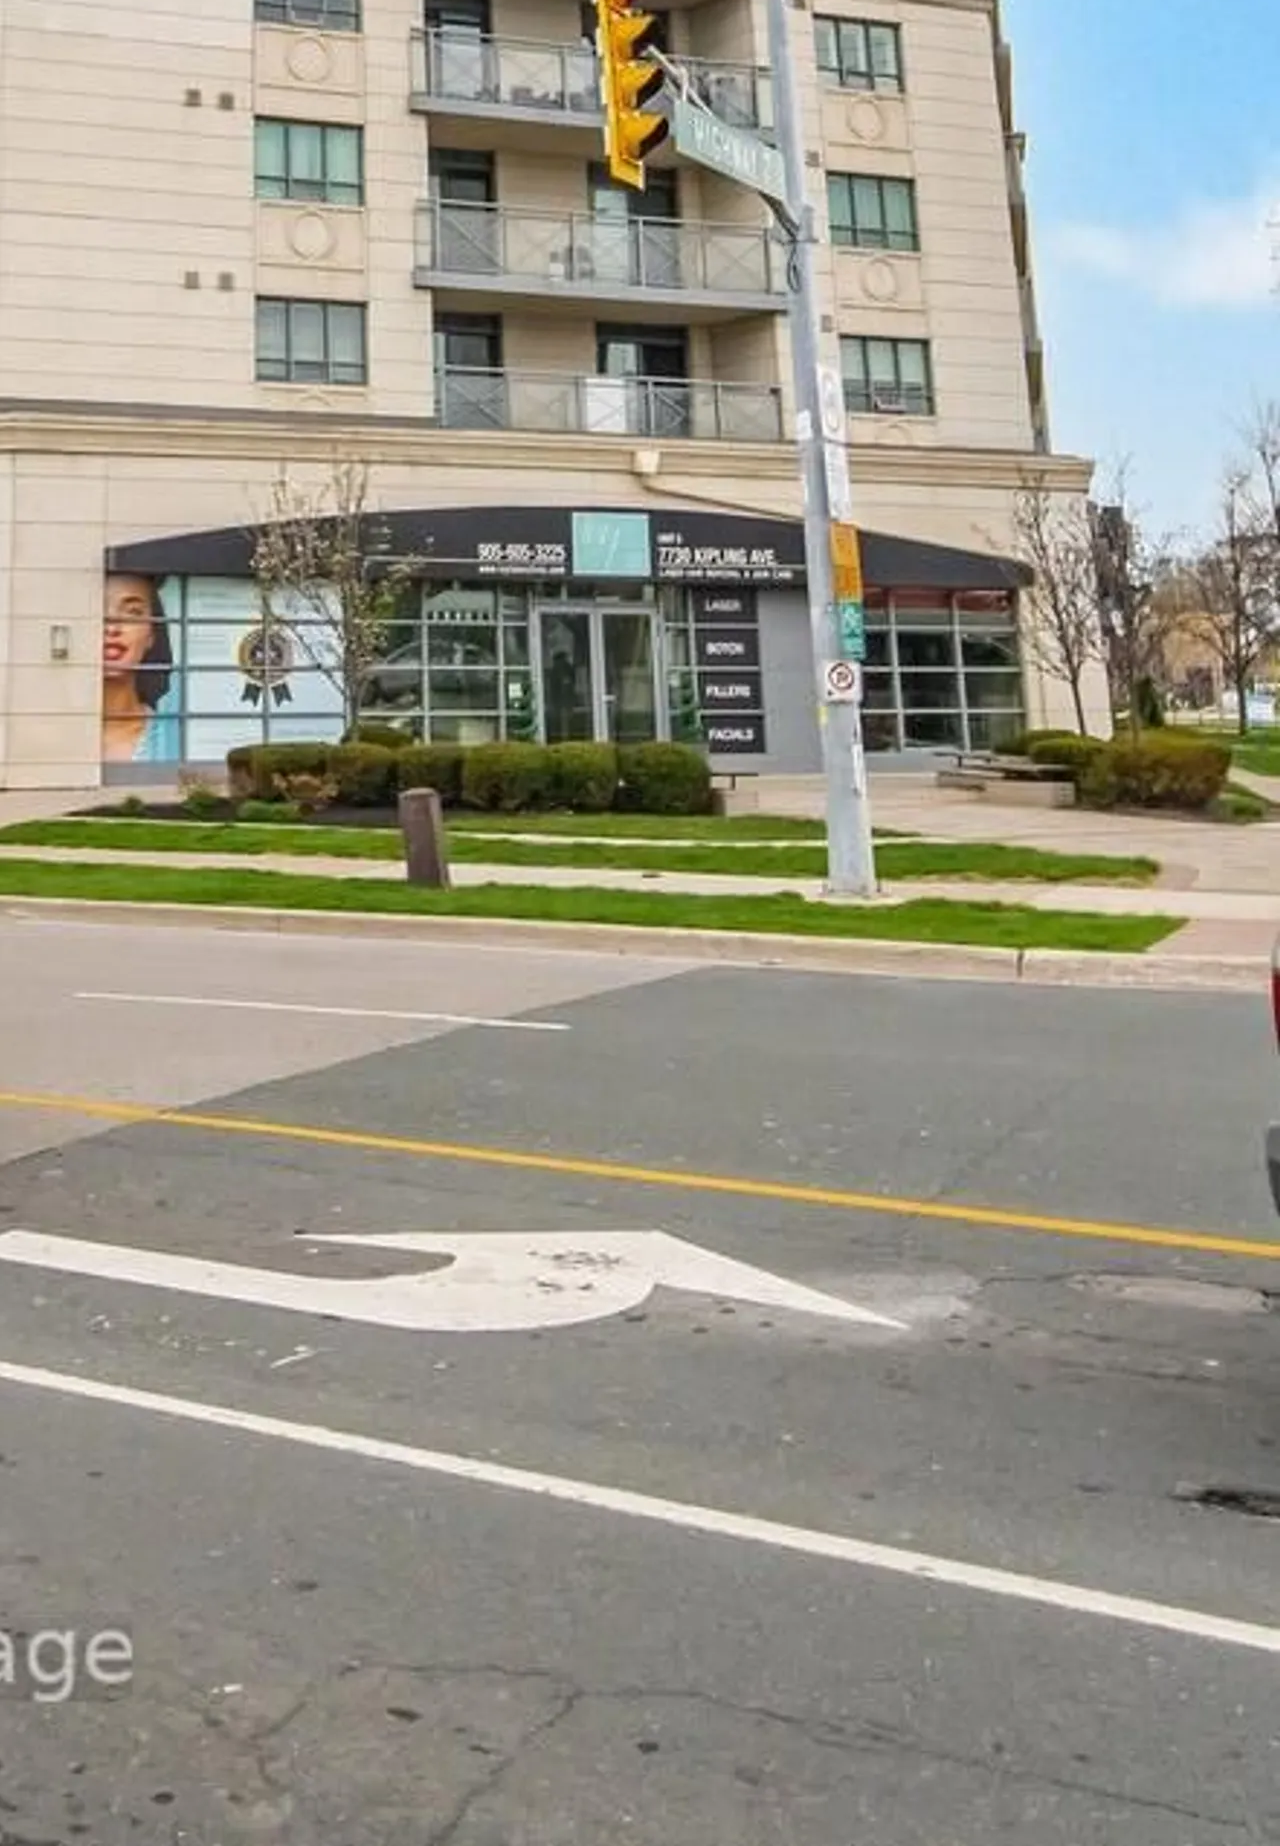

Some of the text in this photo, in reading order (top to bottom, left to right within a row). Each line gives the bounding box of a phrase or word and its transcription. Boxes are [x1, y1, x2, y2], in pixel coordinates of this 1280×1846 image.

[694, 548, 747, 565] KIPLING
[705, 685, 751, 698] FILLERS
[708, 728, 754, 741] FACIALS
